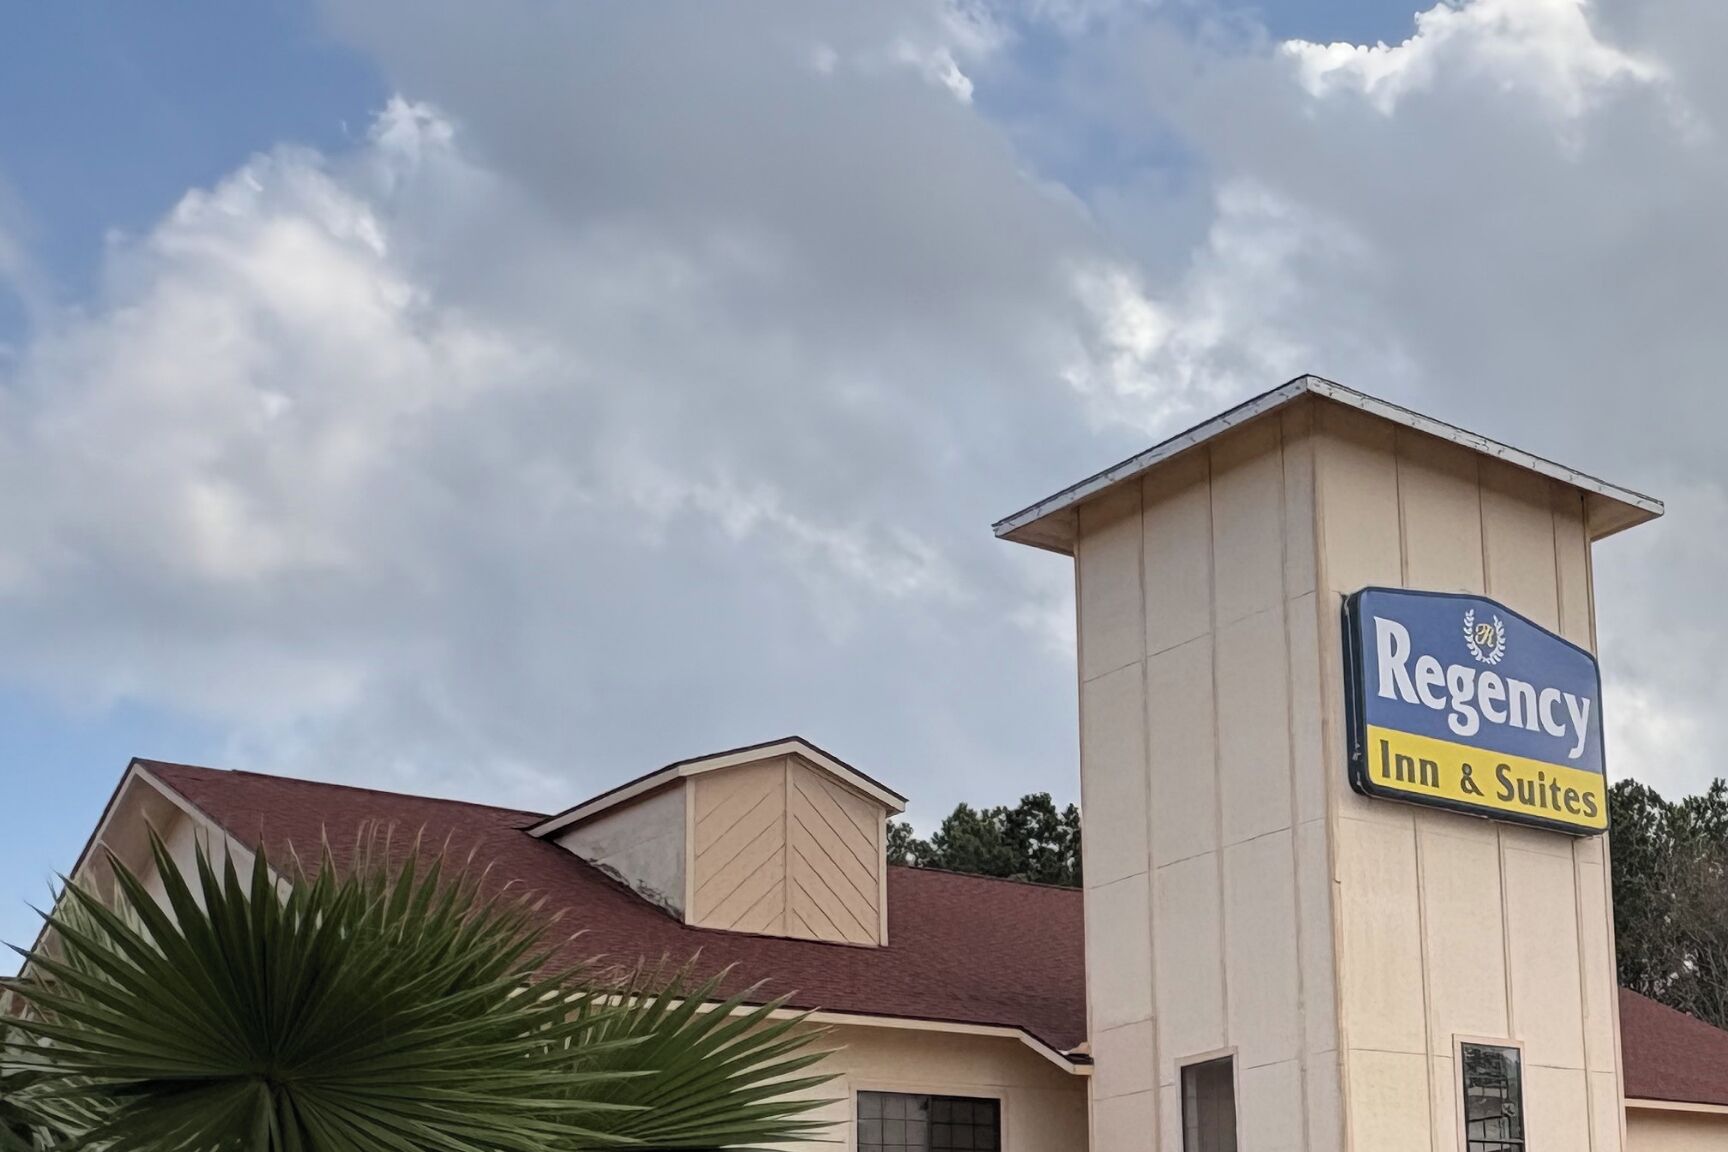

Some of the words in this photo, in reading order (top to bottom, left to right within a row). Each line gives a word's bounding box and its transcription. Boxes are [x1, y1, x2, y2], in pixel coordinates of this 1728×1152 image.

[1373, 616, 1590, 760] Regency
[1379, 739, 1440, 789] Inn
[1460, 762, 1485, 797] &
[1495, 763, 1598, 818] Suites
